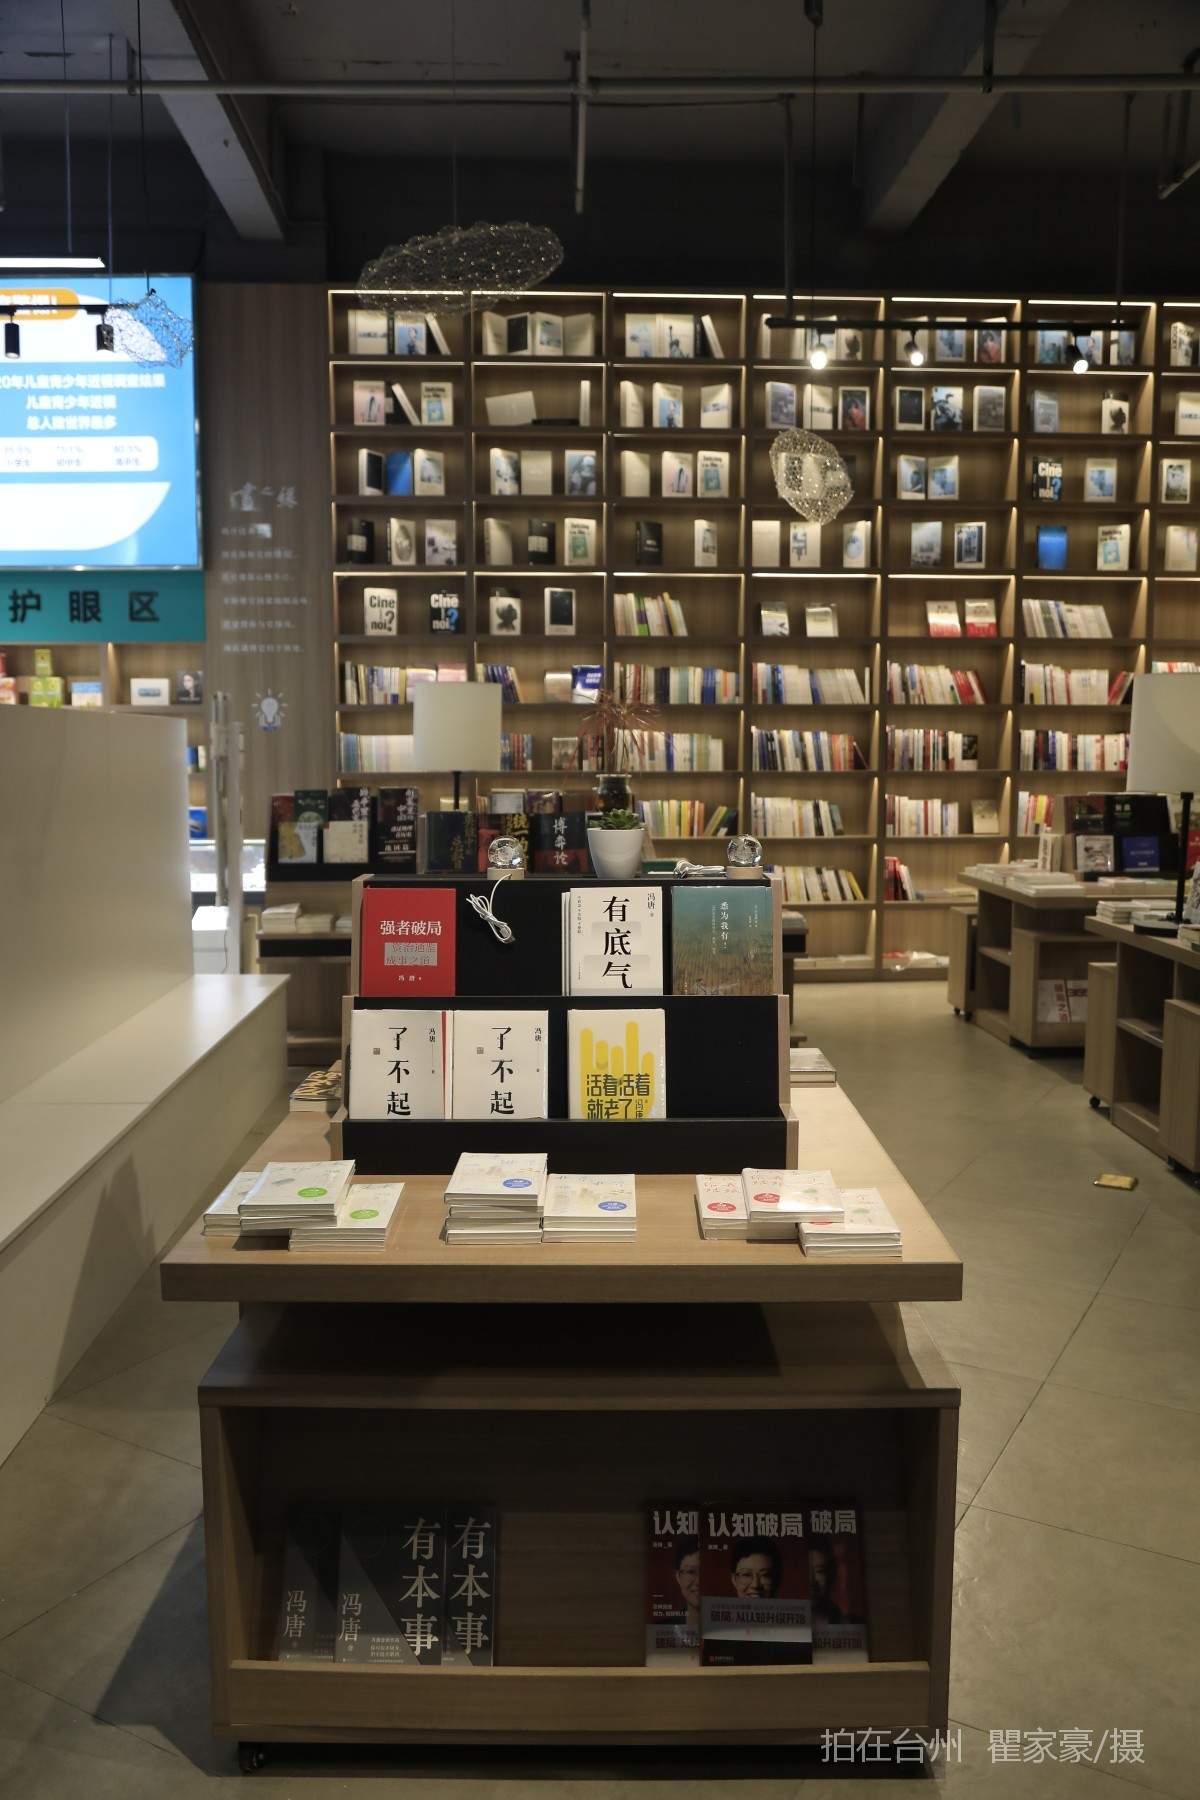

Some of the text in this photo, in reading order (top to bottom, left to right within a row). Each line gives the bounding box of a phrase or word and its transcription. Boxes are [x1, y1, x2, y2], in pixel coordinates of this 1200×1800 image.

[9, 590, 160, 623] 护眼区
[369, 595, 395, 608] Cine
[430, 593, 459, 608] Cine
[552, 816, 568, 865] 博弈论
[647, 892, 655, 909] 冯唐
[380, 920, 441, 935] 强者破局
[602, 896, 632, 988] 有底气
[428, 1028, 436, 1043] 冯唐
[534, 1028, 542, 1042] 冯唐
[387, 1026, 411, 1116] 了不起
[490, 1026, 514, 1115] 了不起
[586, 1073, 650, 1096] 活着活着
[587, 1098, 633, 1119] 就老了
[653, 1510, 699, 1535] 认知
[708, 1511, 804, 1538] 认知破局
[810, 1509, 857, 1534] 破局
[399, 1517, 442, 1657] 有本事
[450, 1516, 493, 1655] 有本事
[283, 1590, 307, 1638] 冯唐
[338, 1592, 362, 1642] 冯唐
